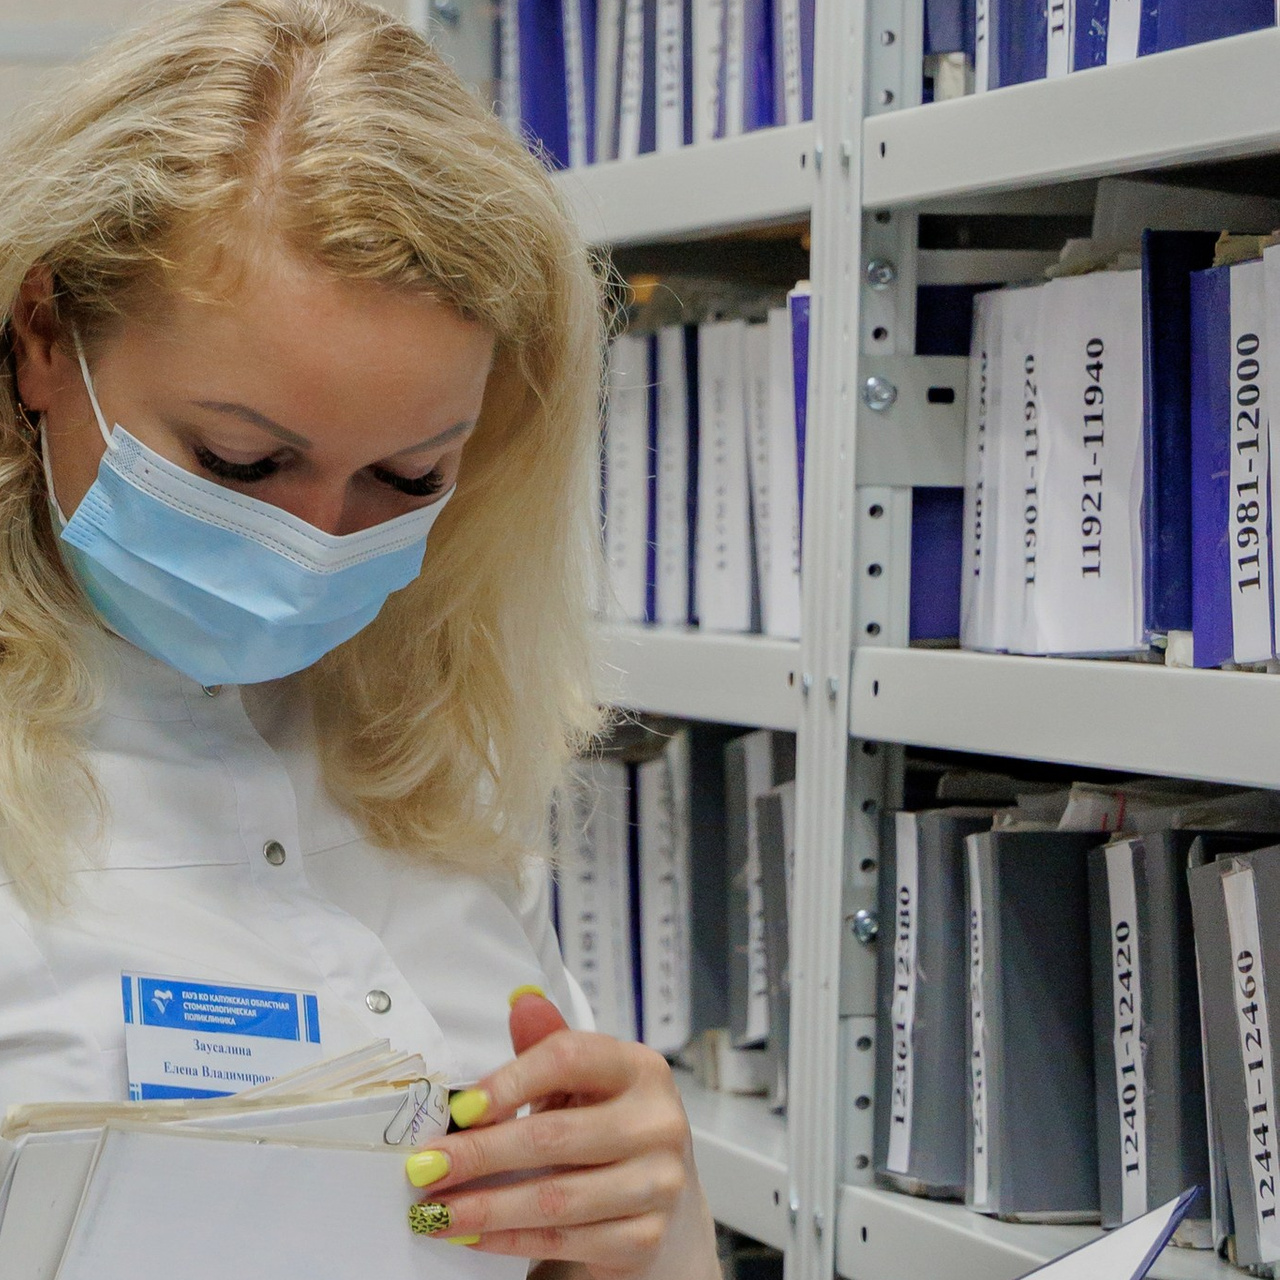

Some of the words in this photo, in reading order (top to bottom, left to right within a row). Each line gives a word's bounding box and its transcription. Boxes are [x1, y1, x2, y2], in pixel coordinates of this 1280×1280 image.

[1024, 354, 1038, 586] 11901-11920
[1081, 337, 1105, 580] 11921-11940
[1235, 332, 1261, 594] 11981-12000
[164, 1061, 198, 1076] Елена
[202, 1065, 276, 1086] Владимиров
[183, 1002, 257, 1017] СТОМАТОЛОГИЧЕСКАЯ
[250, 999, 290, 1010] ОБЛАСТНАЯ
[892, 885, 912, 1126] 12361-12380
[1115, 921, 1142, 1178] 12401-12420
[1237, 950, 1277, 1222] 12441-12460
